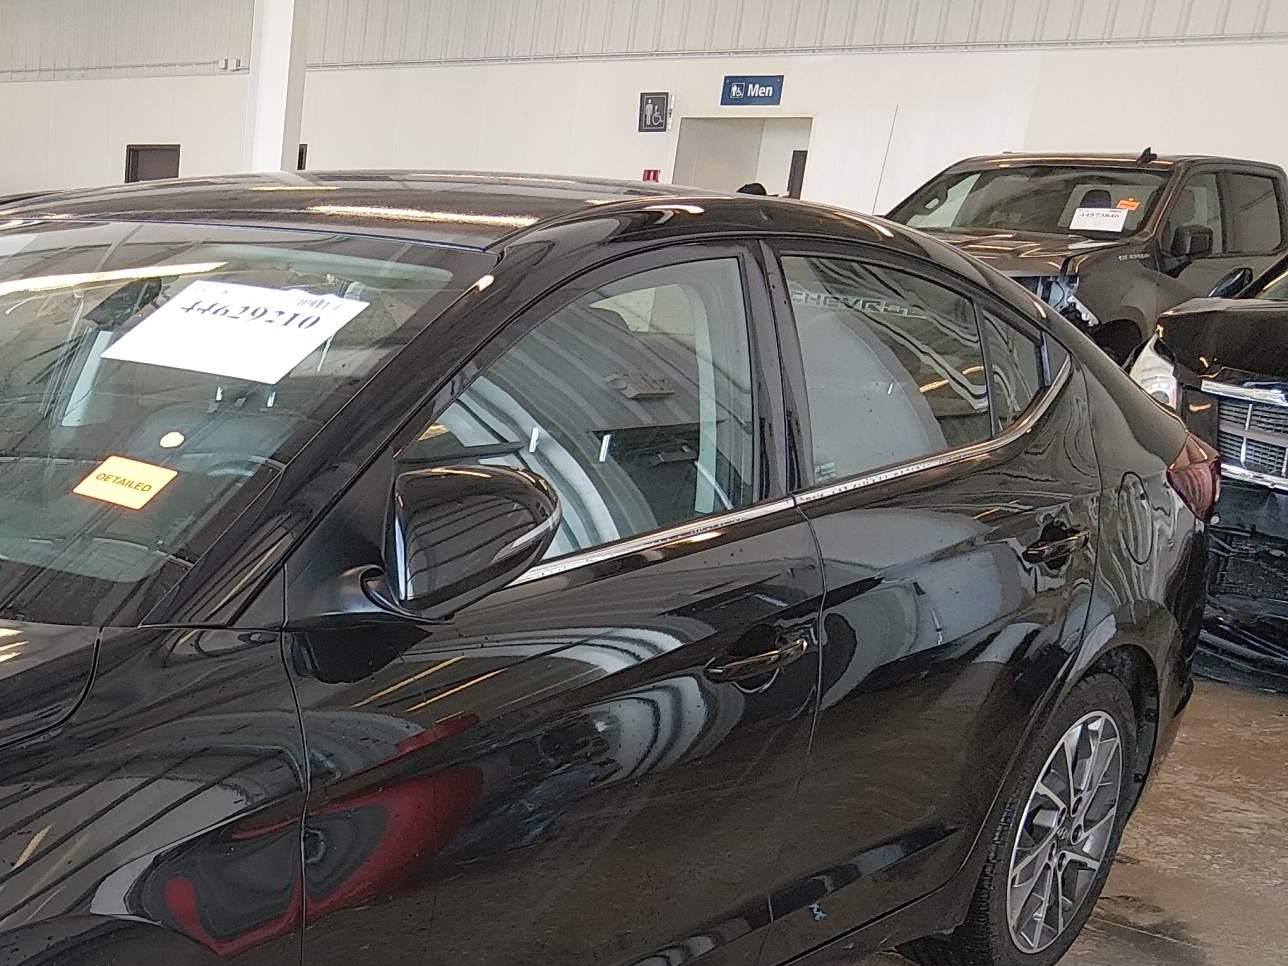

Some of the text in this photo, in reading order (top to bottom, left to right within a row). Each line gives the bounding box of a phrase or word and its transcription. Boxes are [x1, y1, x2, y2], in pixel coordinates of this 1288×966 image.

[747, 83, 774, 98] Men
[180, 300, 321, 331] 44629210
[95, 472, 152, 493] DETAILED
